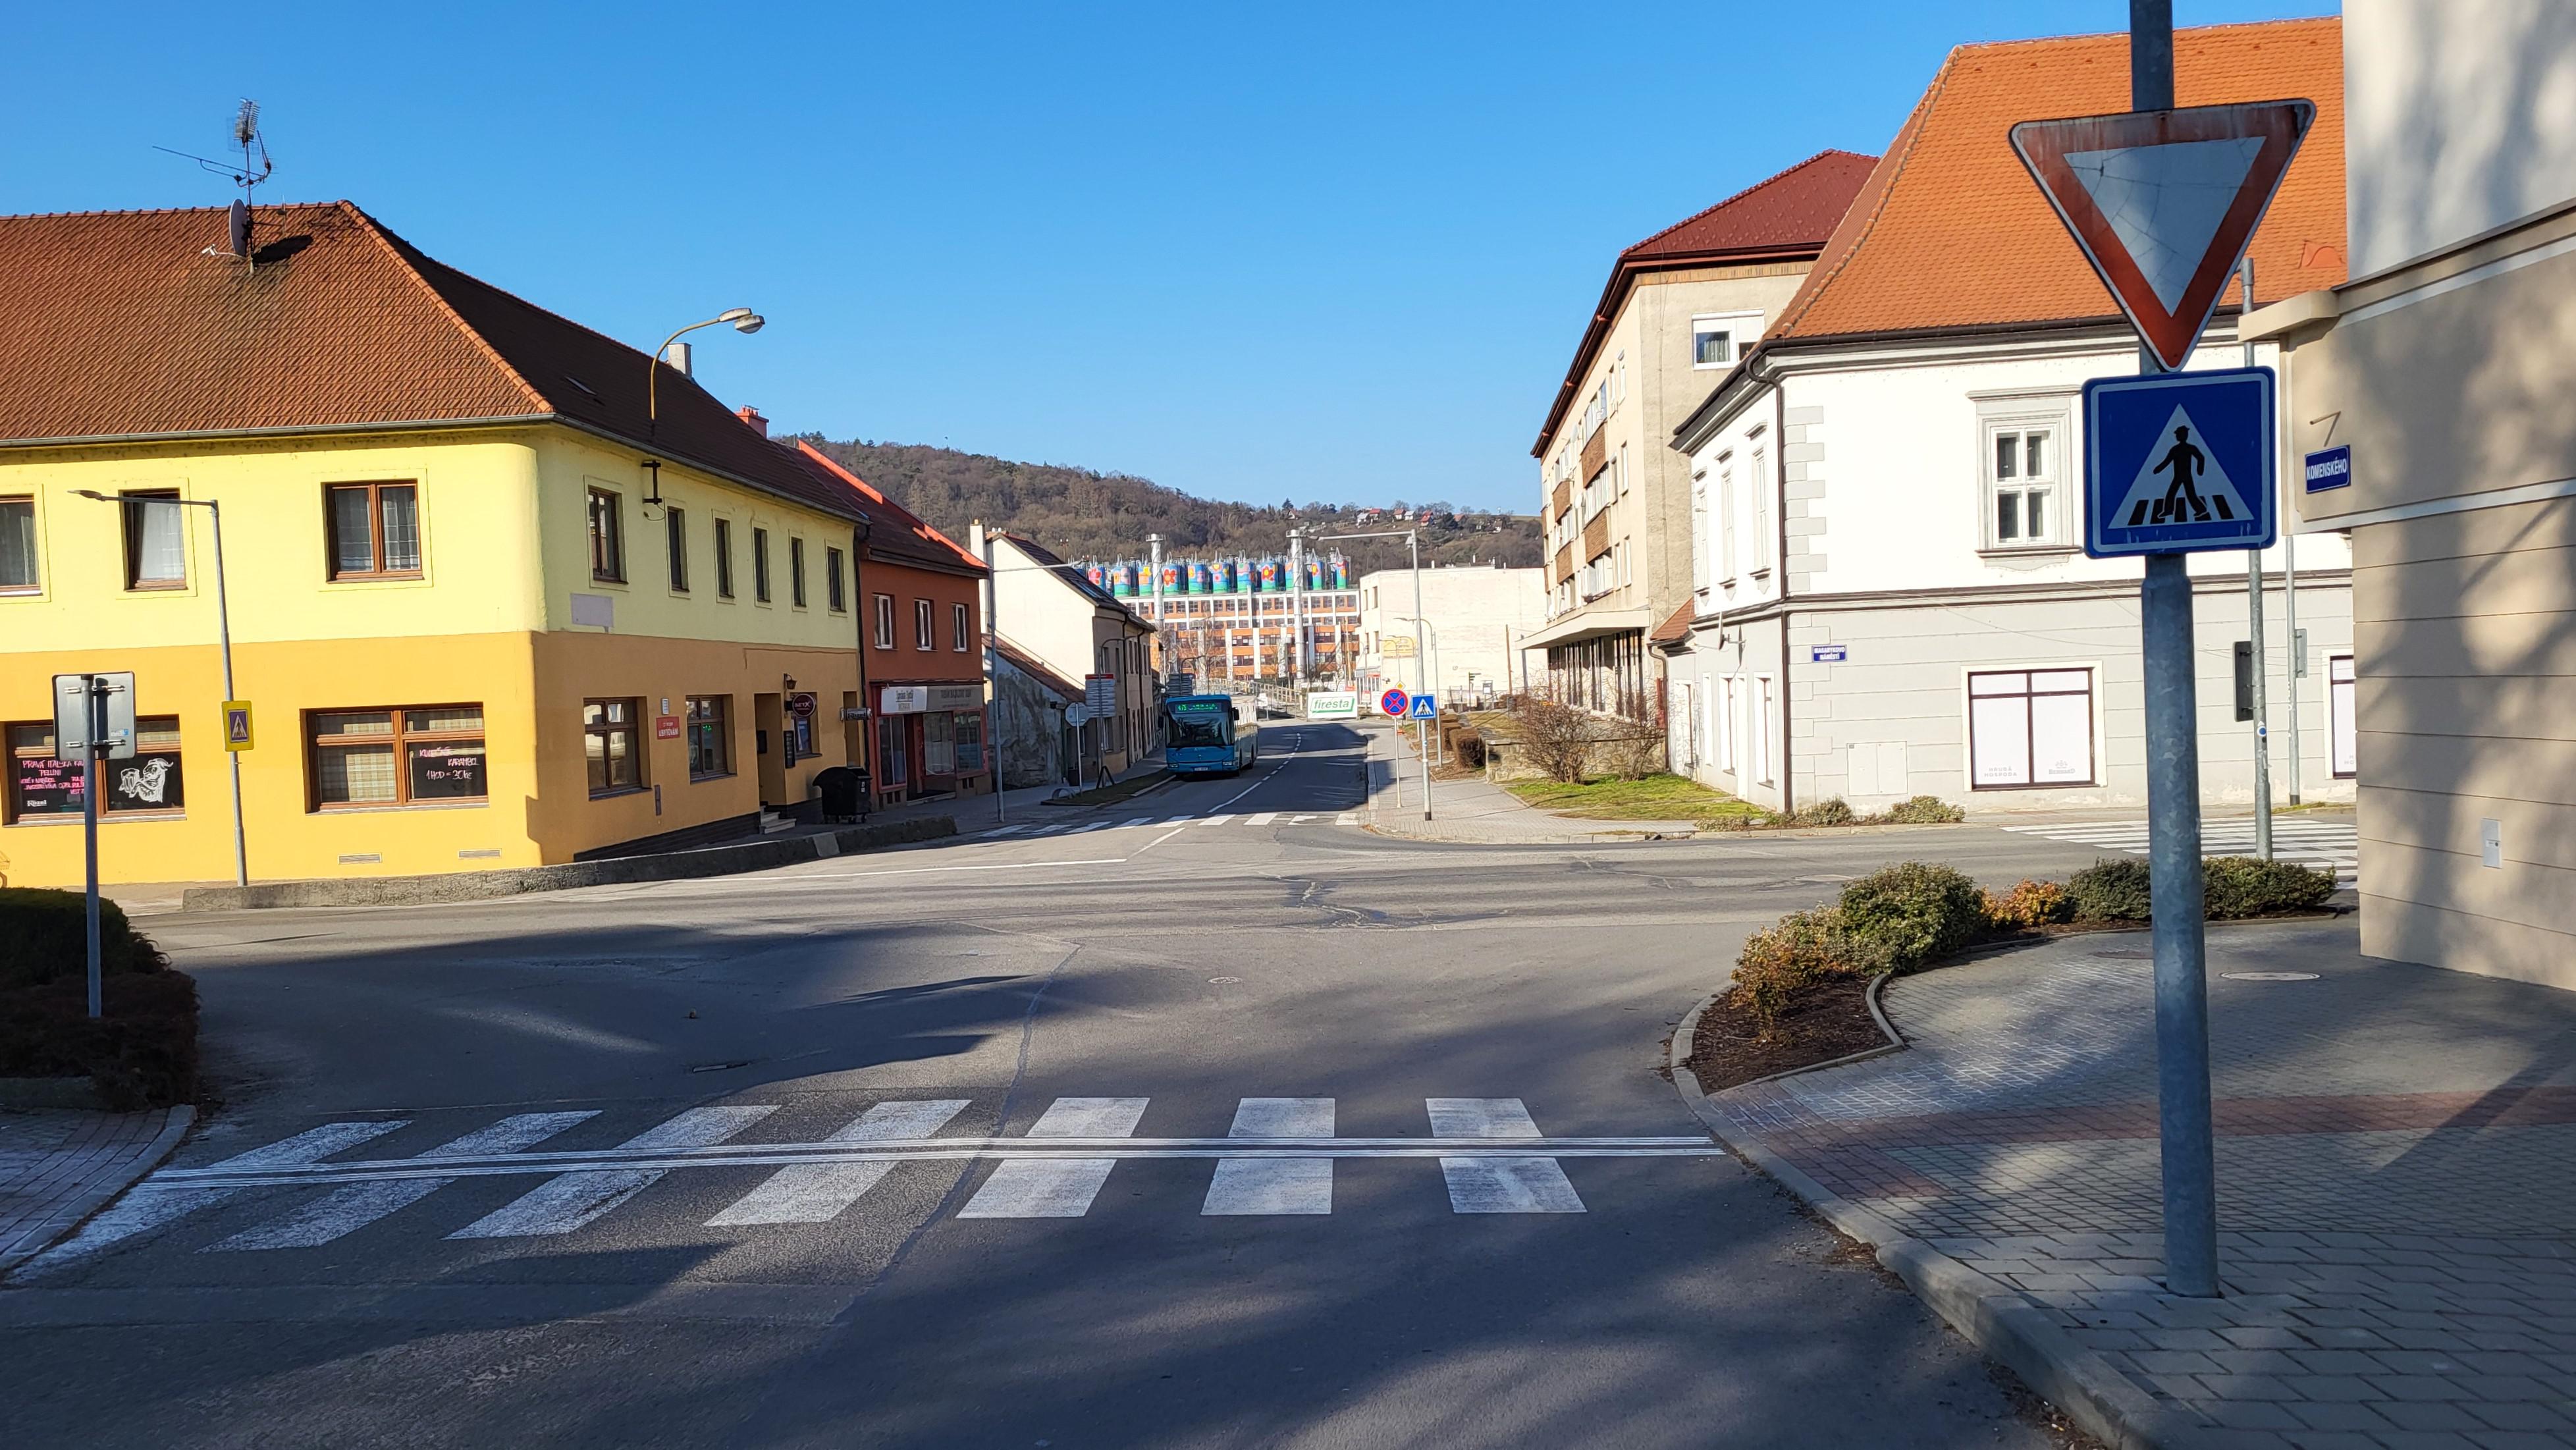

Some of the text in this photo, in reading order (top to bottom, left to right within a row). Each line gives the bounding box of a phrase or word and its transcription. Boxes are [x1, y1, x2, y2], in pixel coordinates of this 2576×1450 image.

[2307, 456, 2347, 481] KOMENSKÉHO
[1314, 699, 1349, 709] firesta
[22, 760, 45, 768] PRAVÁ
